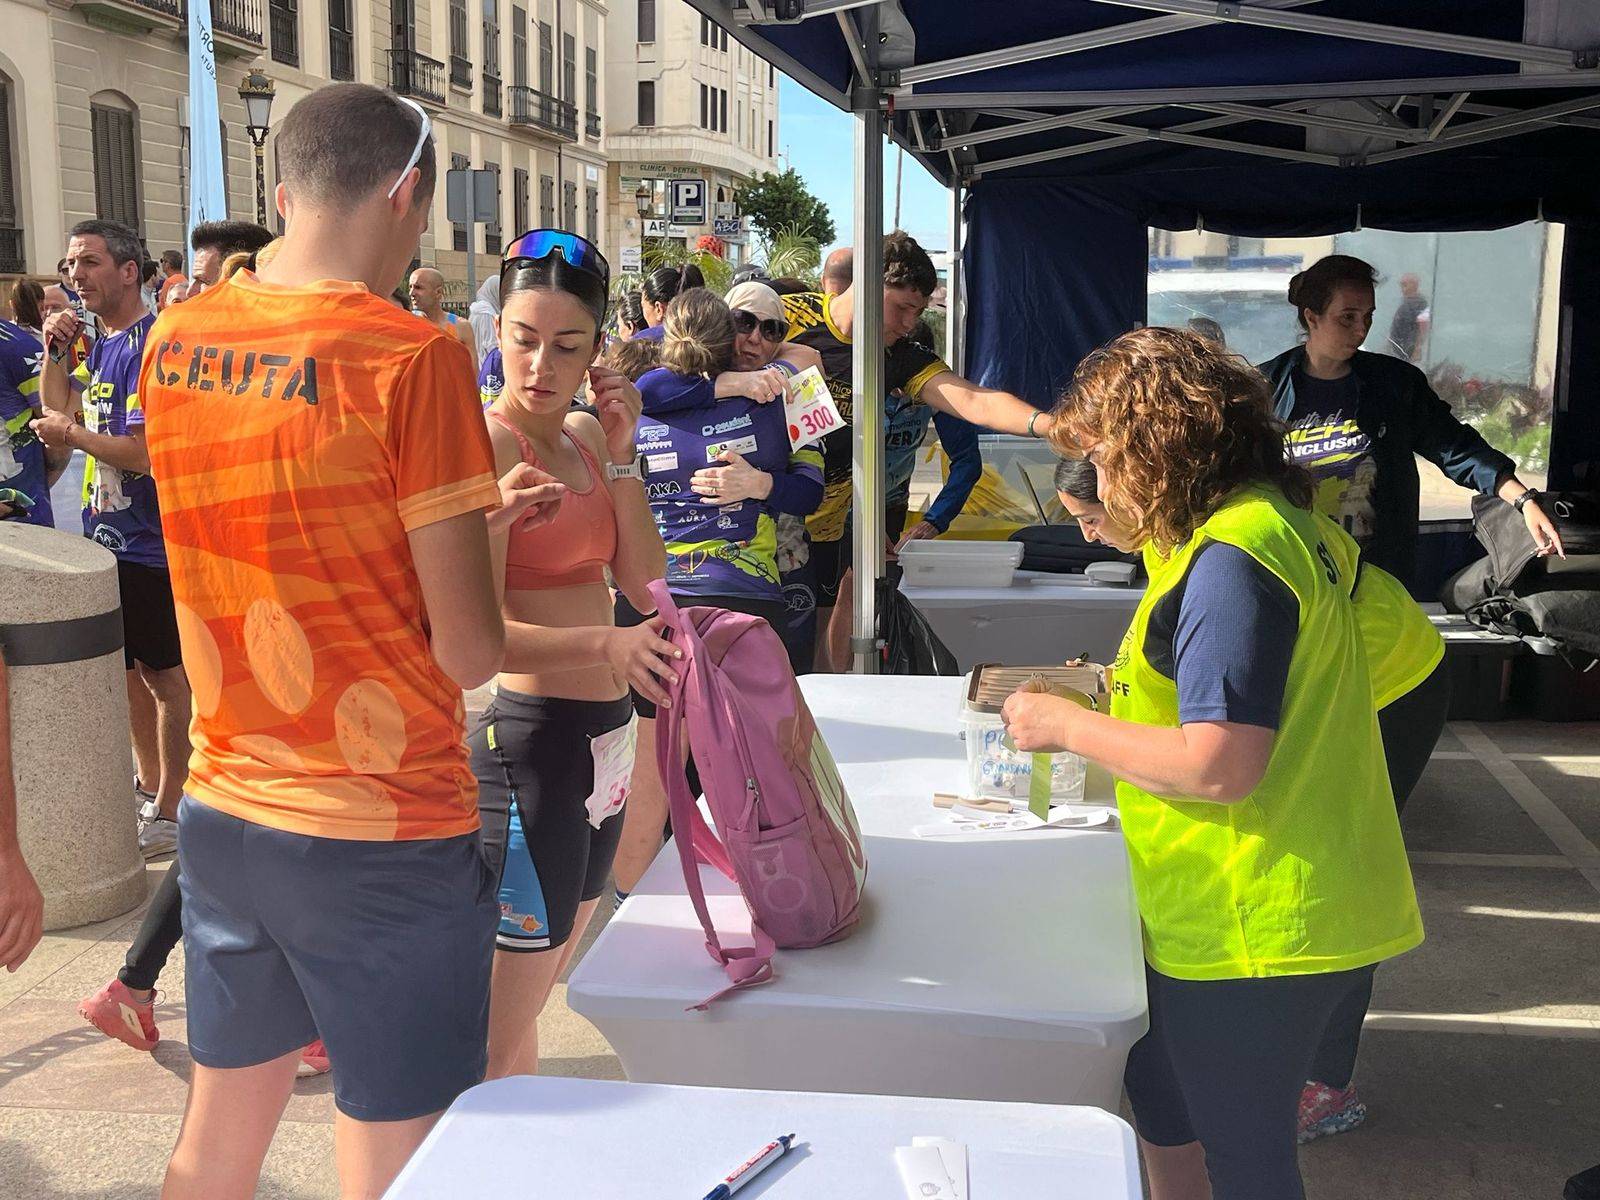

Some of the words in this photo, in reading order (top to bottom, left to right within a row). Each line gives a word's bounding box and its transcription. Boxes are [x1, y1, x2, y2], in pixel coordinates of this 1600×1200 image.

[679, 184, 698, 206] P
[715, 222, 739, 232] ABC
[156, 341, 318, 405] CEUTA
[800, 406, 834, 436] 300
[646, 481, 681, 498] AKA
[679, 514, 708, 523] AURA
